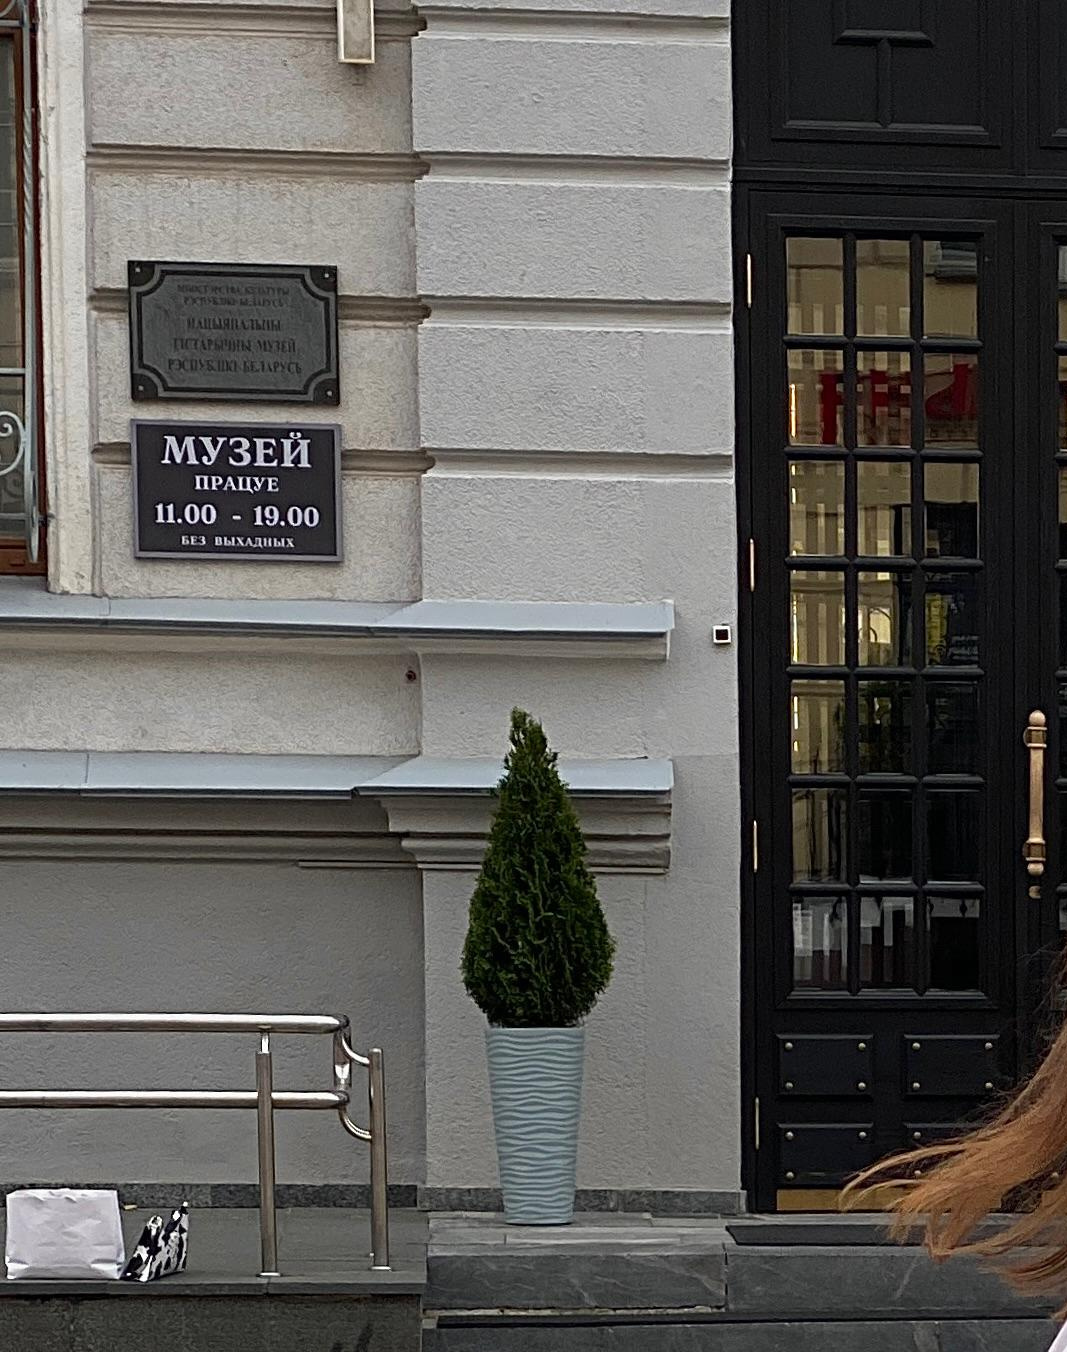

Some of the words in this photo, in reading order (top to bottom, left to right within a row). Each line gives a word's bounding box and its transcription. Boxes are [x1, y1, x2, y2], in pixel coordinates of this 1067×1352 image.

[160, 431, 313, 468] МУЗЕЙ
[194, 475, 280, 494] ПРАЦУЕ
[154, 502, 217, 525] 11.00
[253, 505, 320, 527] 19.00
[181, 535, 206, 546] БЕЗ
[214, 536, 295, 549] ВЫХАДНЫХ
